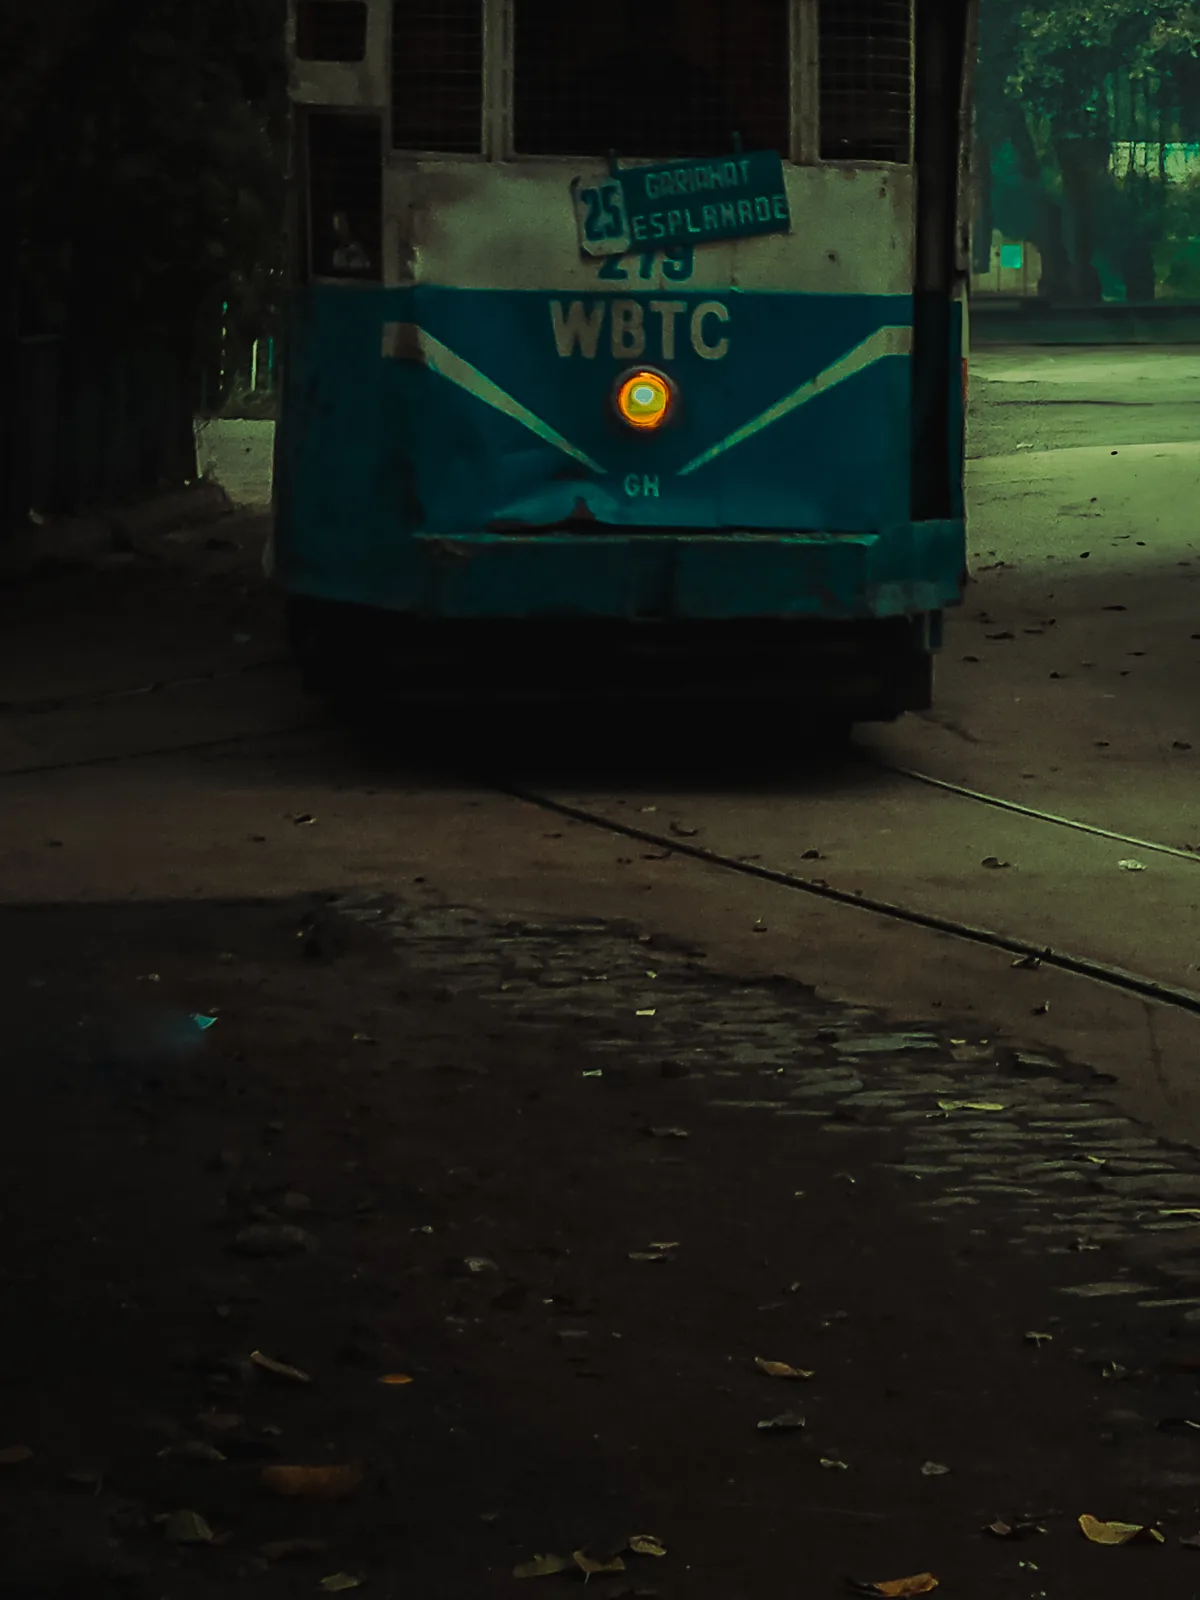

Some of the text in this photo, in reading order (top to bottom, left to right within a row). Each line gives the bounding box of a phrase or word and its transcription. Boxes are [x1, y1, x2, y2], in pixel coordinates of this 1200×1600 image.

[580, 185, 624, 241] 25
[632, 194, 789, 240] ESPLANADE
[549, 299, 731, 361] WBTC
